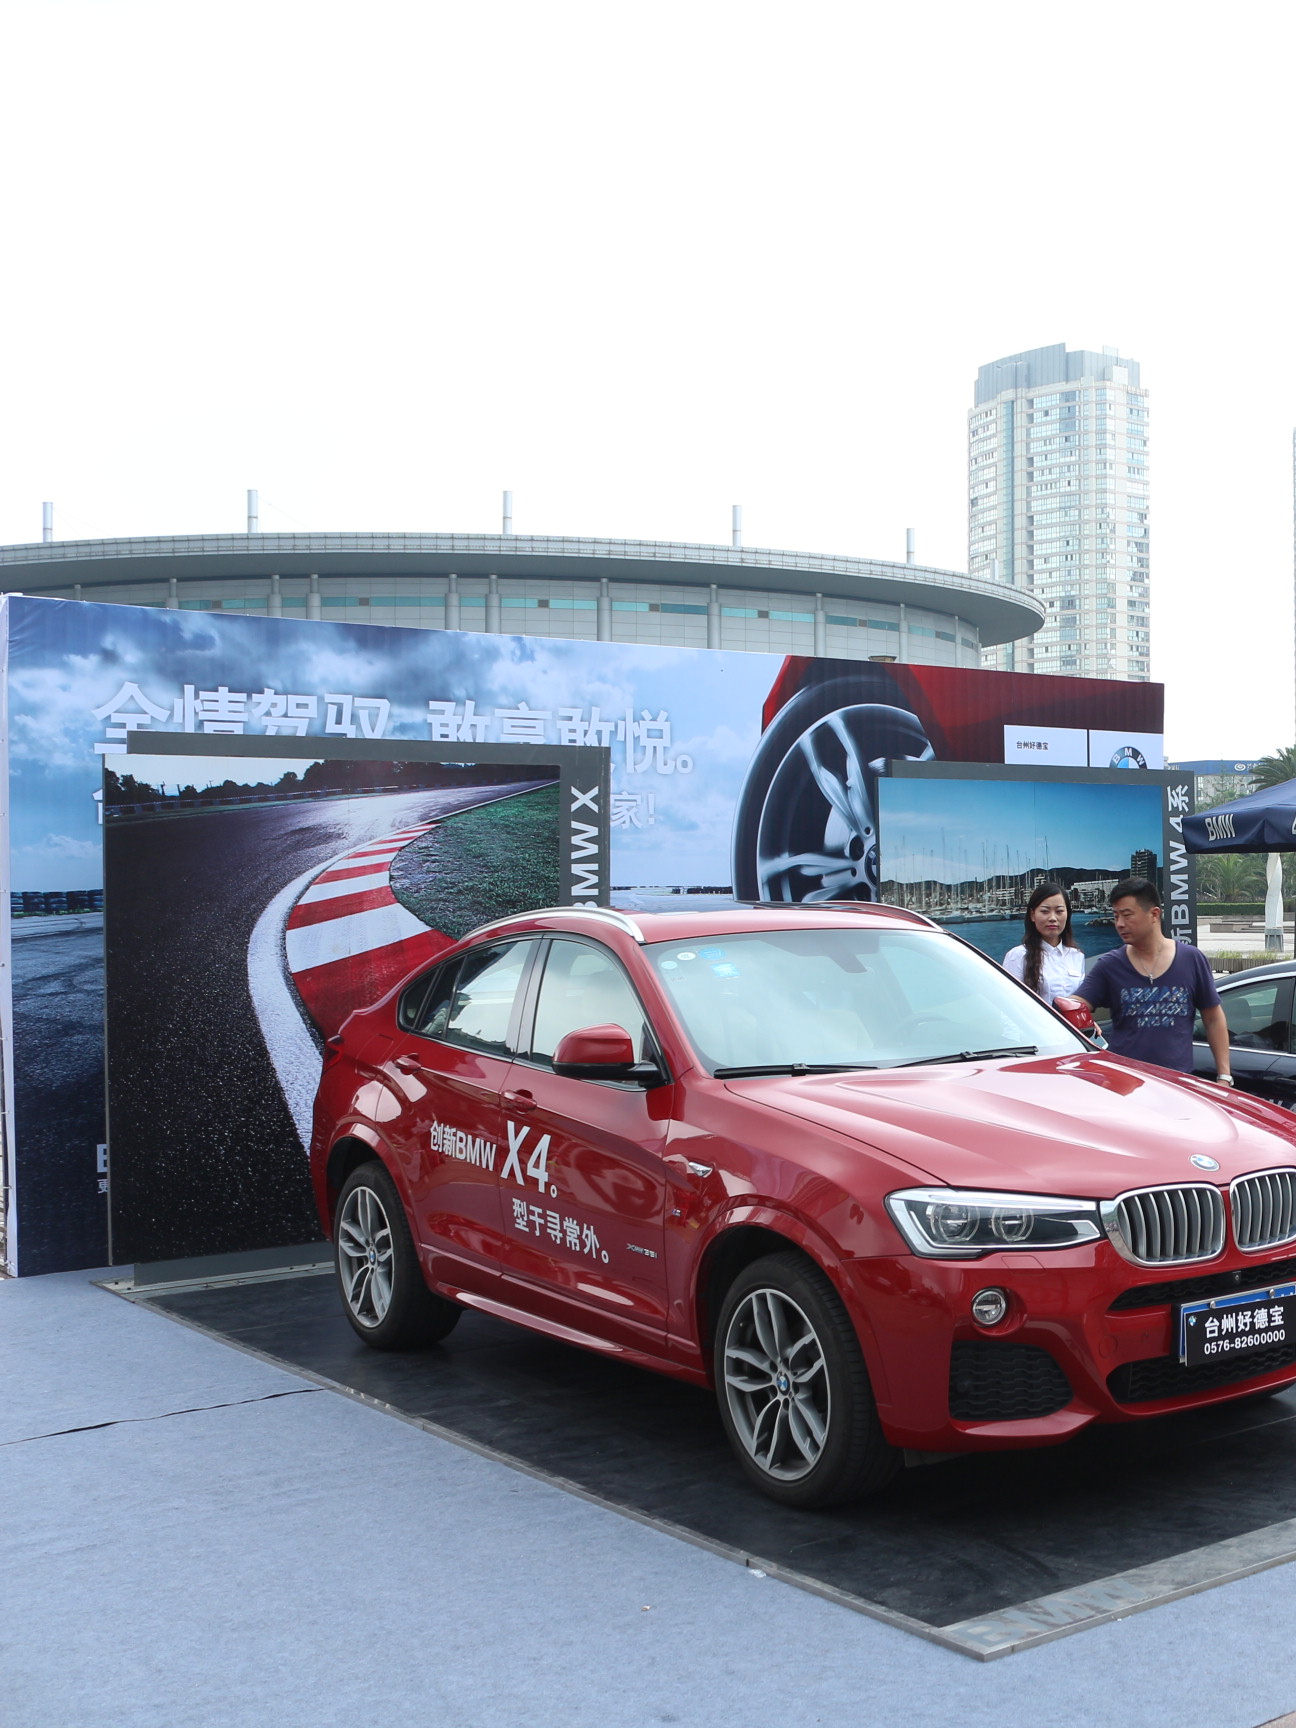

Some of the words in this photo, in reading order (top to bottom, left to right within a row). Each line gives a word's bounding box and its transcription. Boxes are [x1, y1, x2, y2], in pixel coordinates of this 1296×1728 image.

[91, 682, 391, 754] 全情驾驭
[1017, 741, 1049, 750] 台州好德宝
[571, 785, 599, 813] X
[1205, 814, 1236, 841] BMW
[431, 1120, 497, 1171] 创新BMW
[1204, 1305, 1284, 1339] 台州好德宝
[1204, 1329, 1286, 1355] 0576-82600000
